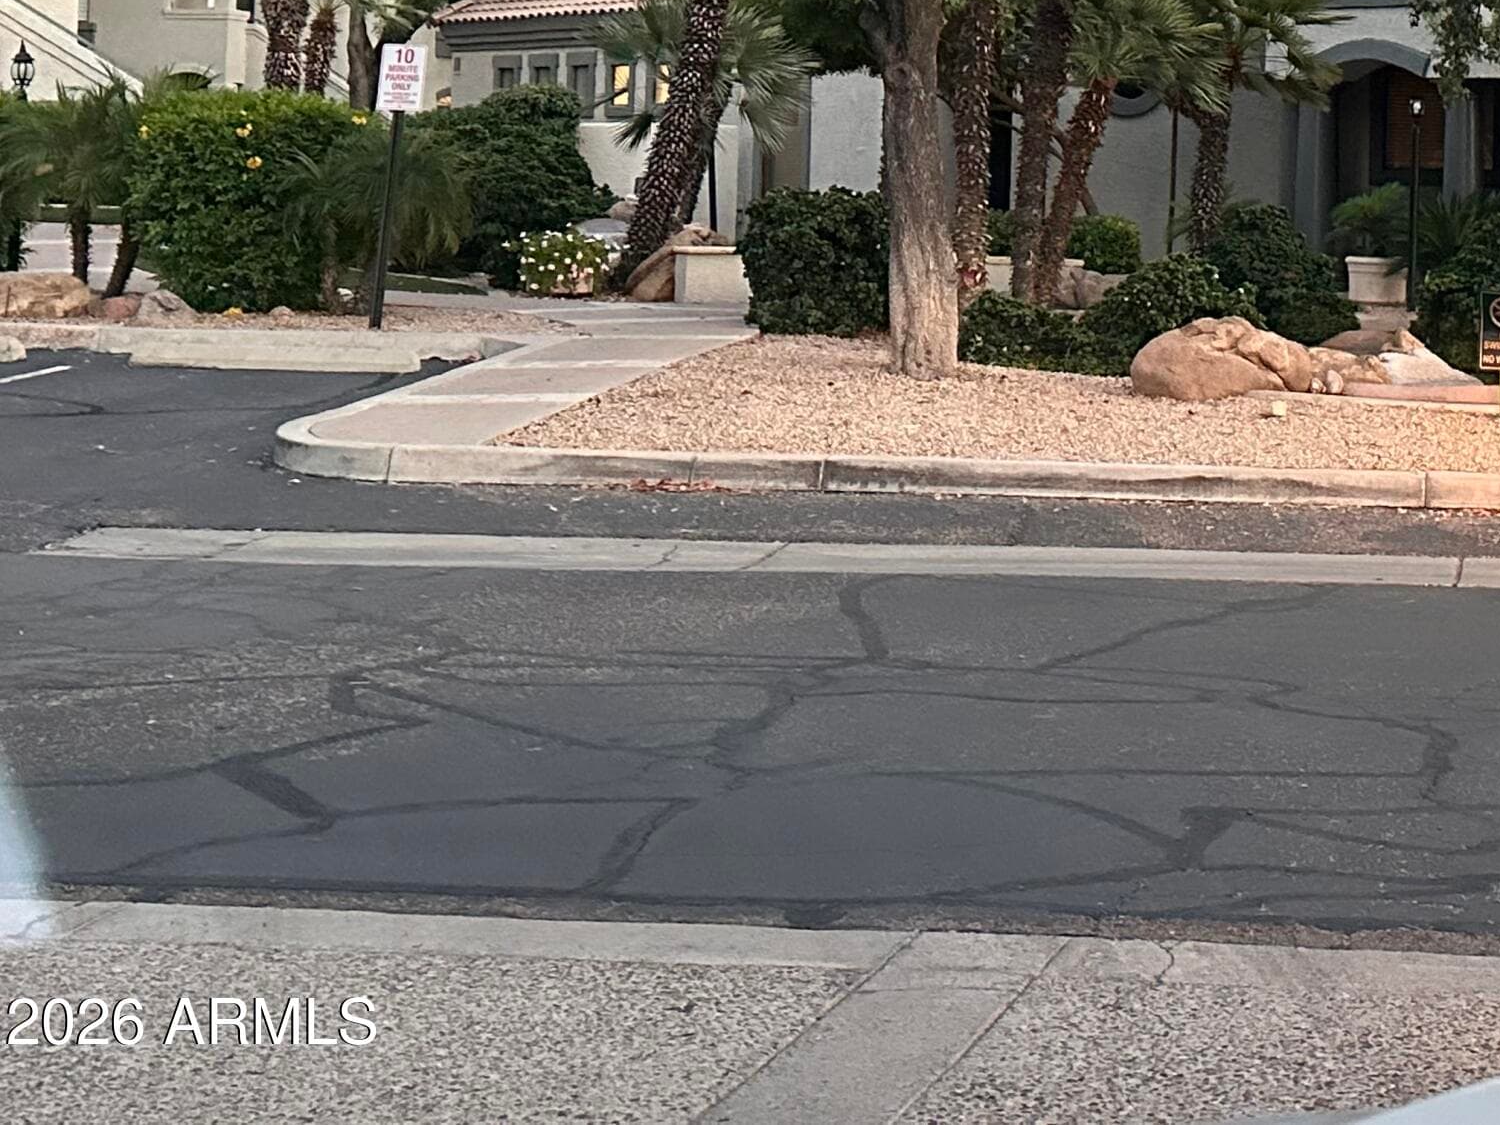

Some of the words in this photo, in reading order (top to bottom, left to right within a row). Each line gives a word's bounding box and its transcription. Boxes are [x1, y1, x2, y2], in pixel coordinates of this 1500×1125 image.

[395, 48, 415, 64] 10
[388, 64, 418, 73] MINUTE
[385, 73, 420, 82] PARKING
[391, 82, 411, 90] ONLY
[1482, 354, 1495, 364] NO
